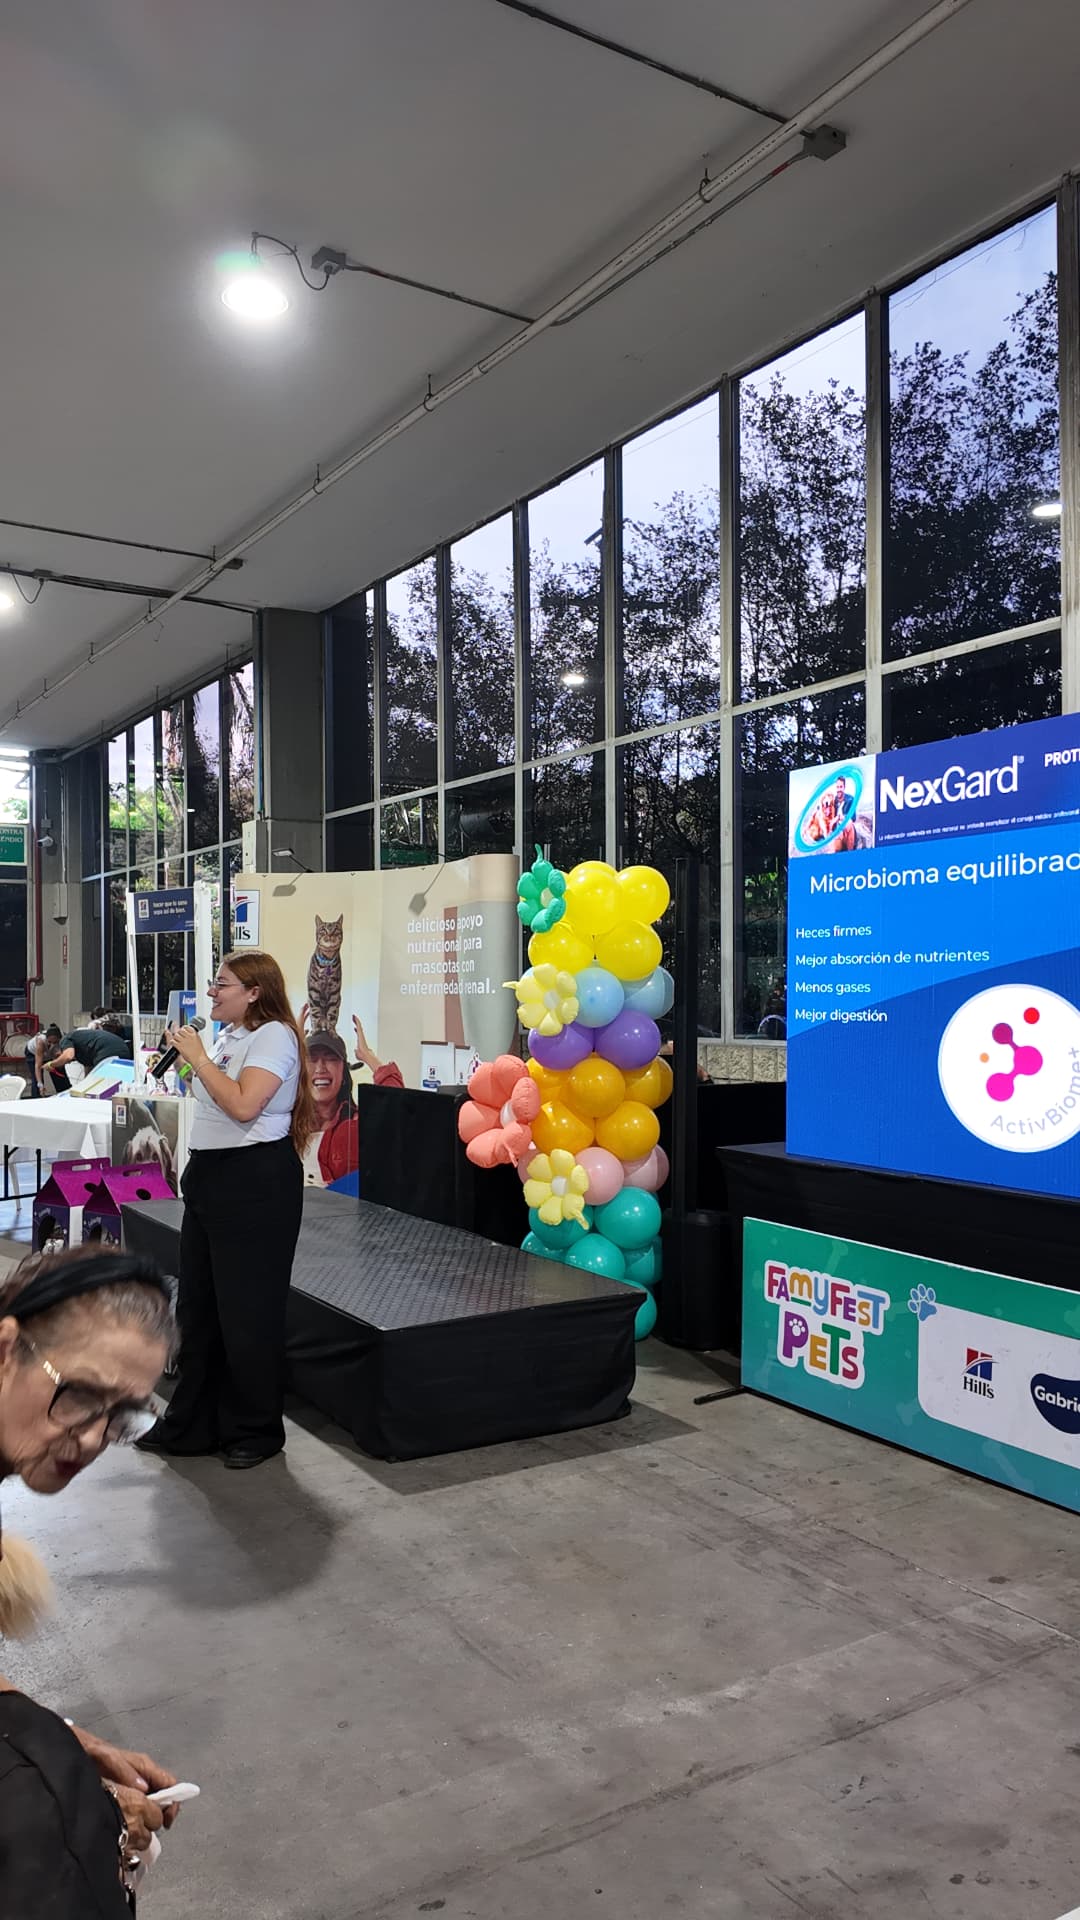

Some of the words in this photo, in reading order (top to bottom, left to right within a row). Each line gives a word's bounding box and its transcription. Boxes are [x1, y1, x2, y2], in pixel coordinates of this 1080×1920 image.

[1045, 748, 1080, 768] PROT
[810, 866, 939, 894] Microbioma
[407, 918, 456, 933] delicioso
[457, 914, 483, 932] apoyo
[795, 926, 831, 939] Heces
[833, 925, 872, 937] firmes
[407, 936, 462, 953] nutricional
[463, 936, 482, 953] para
[411, 961, 459, 974] mascotas
[461, 960, 475, 973] con
[795, 954, 828, 968] Mejor
[830, 951, 890, 965] absorción
[894, 951, 911, 963] de
[915, 949, 990, 963] nutrientes
[400, 979, 463, 995] enfermedad
[464, 977, 496, 994] renal.
[795, 982, 833, 993] Menos
[835, 983, 871, 995] gases
[795, 1009, 826, 1022] Mejor
[830, 1008, 888, 1024] digestión
[963, 1375, 995, 1399] Hill's
